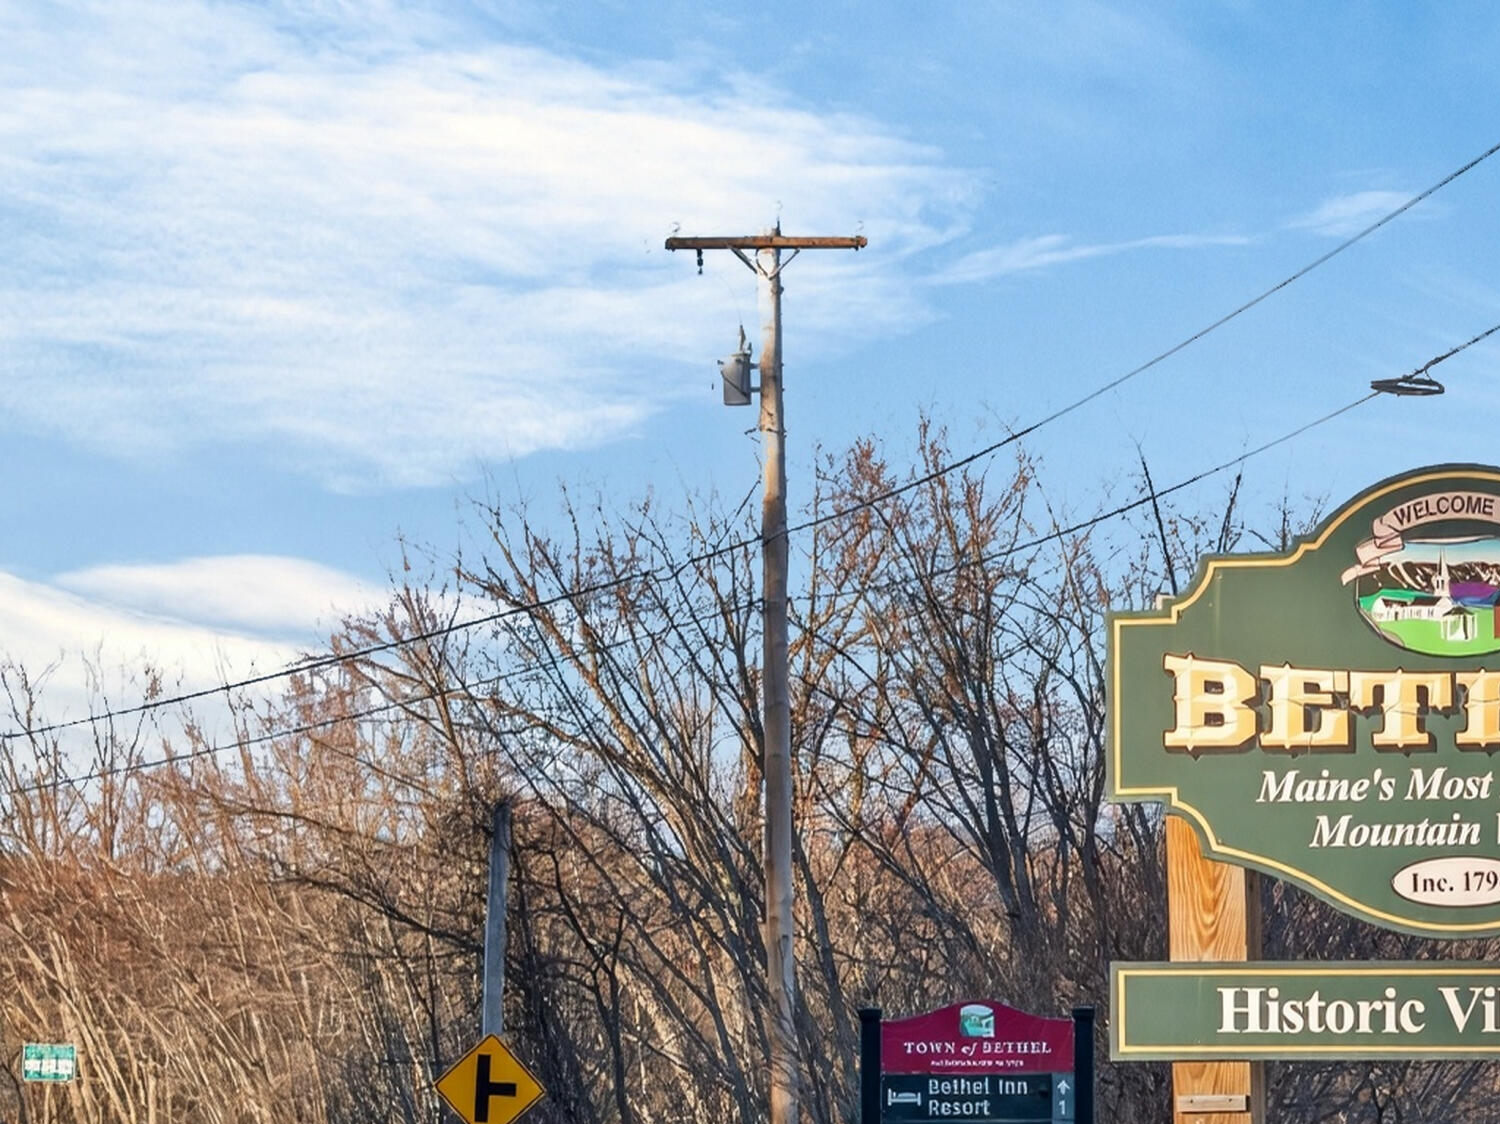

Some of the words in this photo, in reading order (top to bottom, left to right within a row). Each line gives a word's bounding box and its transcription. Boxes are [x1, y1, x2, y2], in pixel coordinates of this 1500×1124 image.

[1394, 496, 1493, 526] WELCOME
[1256, 768, 1395, 802] Maine's
[1405, 766, 1493, 800] Most
[1310, 813, 1481, 847] Mountain
[1412, 872, 1454, 892] Inc.
[1217, 986, 1425, 1034] Historic
[904, 1042, 955, 1054] TOWN
[961, 1042, 977, 1056] of
[982, 1042, 1051, 1054] BETHEL
[928, 1077, 989, 1095] Bethel
[999, 1079, 1028, 1095] Inn
[928, 1100, 990, 1116] Resort
